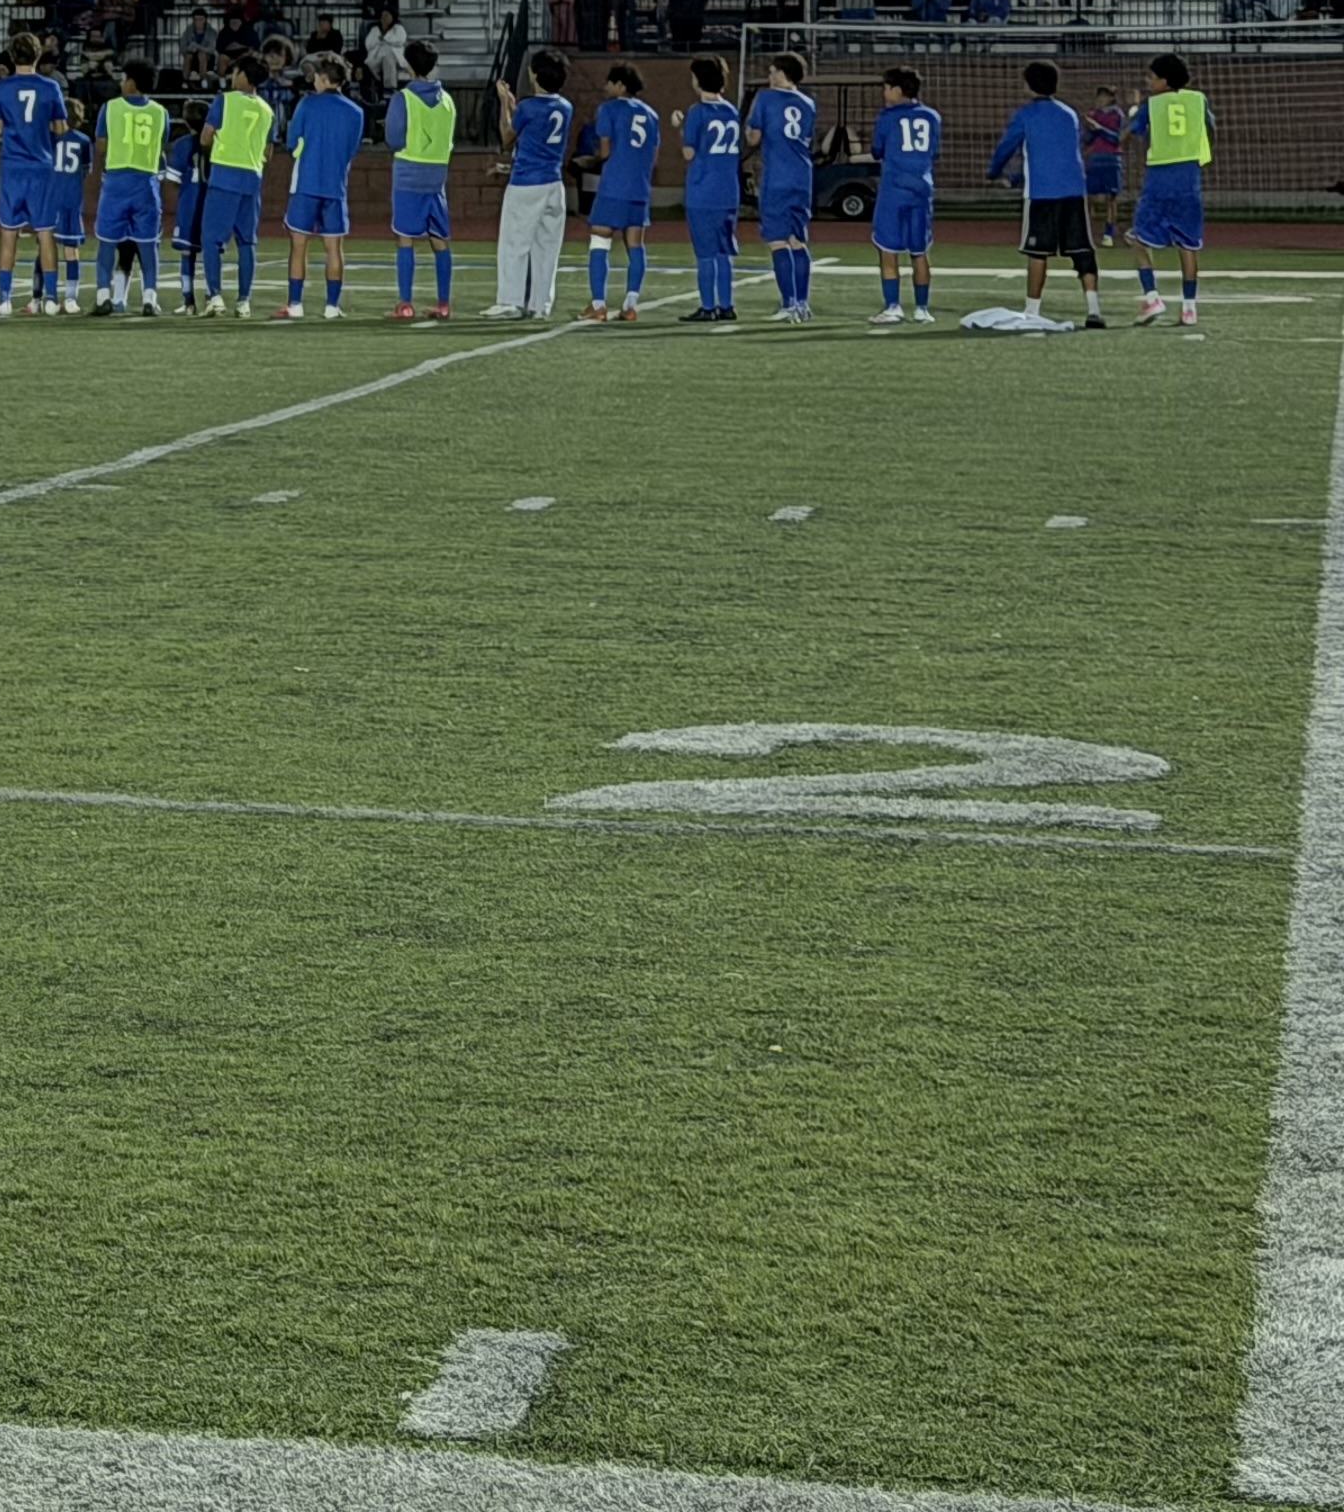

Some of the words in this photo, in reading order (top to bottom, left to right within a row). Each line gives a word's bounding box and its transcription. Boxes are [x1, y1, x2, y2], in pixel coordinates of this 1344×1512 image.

[19, 90, 35, 122] 7
[124, 113, 153, 146] 16
[547, 111, 563, 143] 2
[631, 115, 646, 147] 5
[708, 120, 739, 153] 22
[784, 107, 801, 139] 8
[900, 118, 929, 151] 13
[55, 141, 80, 172] 15
[544, 720, 1174, 831] 2
